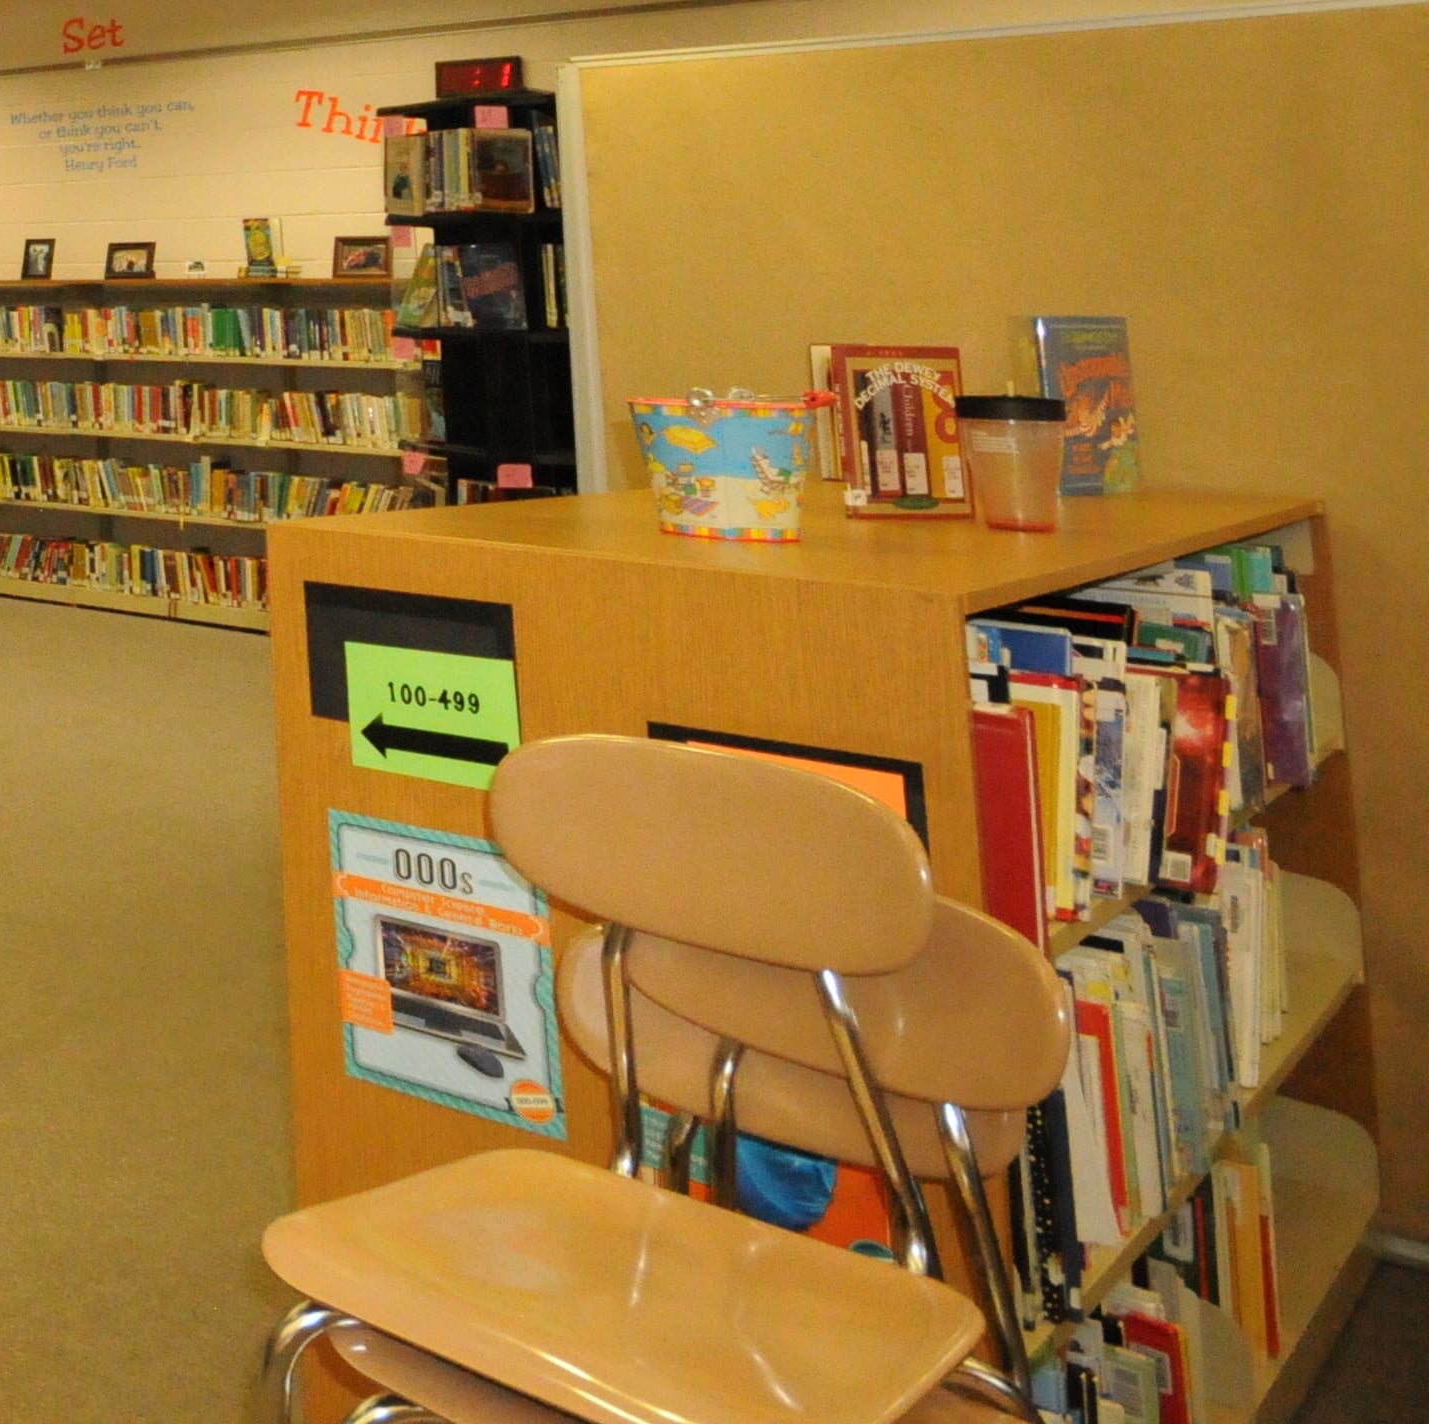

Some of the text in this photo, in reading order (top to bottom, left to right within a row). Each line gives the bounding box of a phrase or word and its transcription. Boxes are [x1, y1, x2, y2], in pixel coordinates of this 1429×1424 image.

[61, 17, 125, 54] Set
[10, 111, 64, 126] Whether
[68, 109, 93, 123] you
[97, 104, 133, 118] think
[136, 103, 162, 116] you
[56, 125, 91, 138] think
[94, 126, 121, 138] you
[65, 154, 138, 173] Henry Ford
[865, 361, 941, 382] THE DEWEY
[854, 374, 907, 410] DECIMAL
[388, 681, 480, 715] 100-499
[395, 848, 474, 895] 000s
[380, 883, 435, 904] Computer
[488, 917, 523, 935] Works
